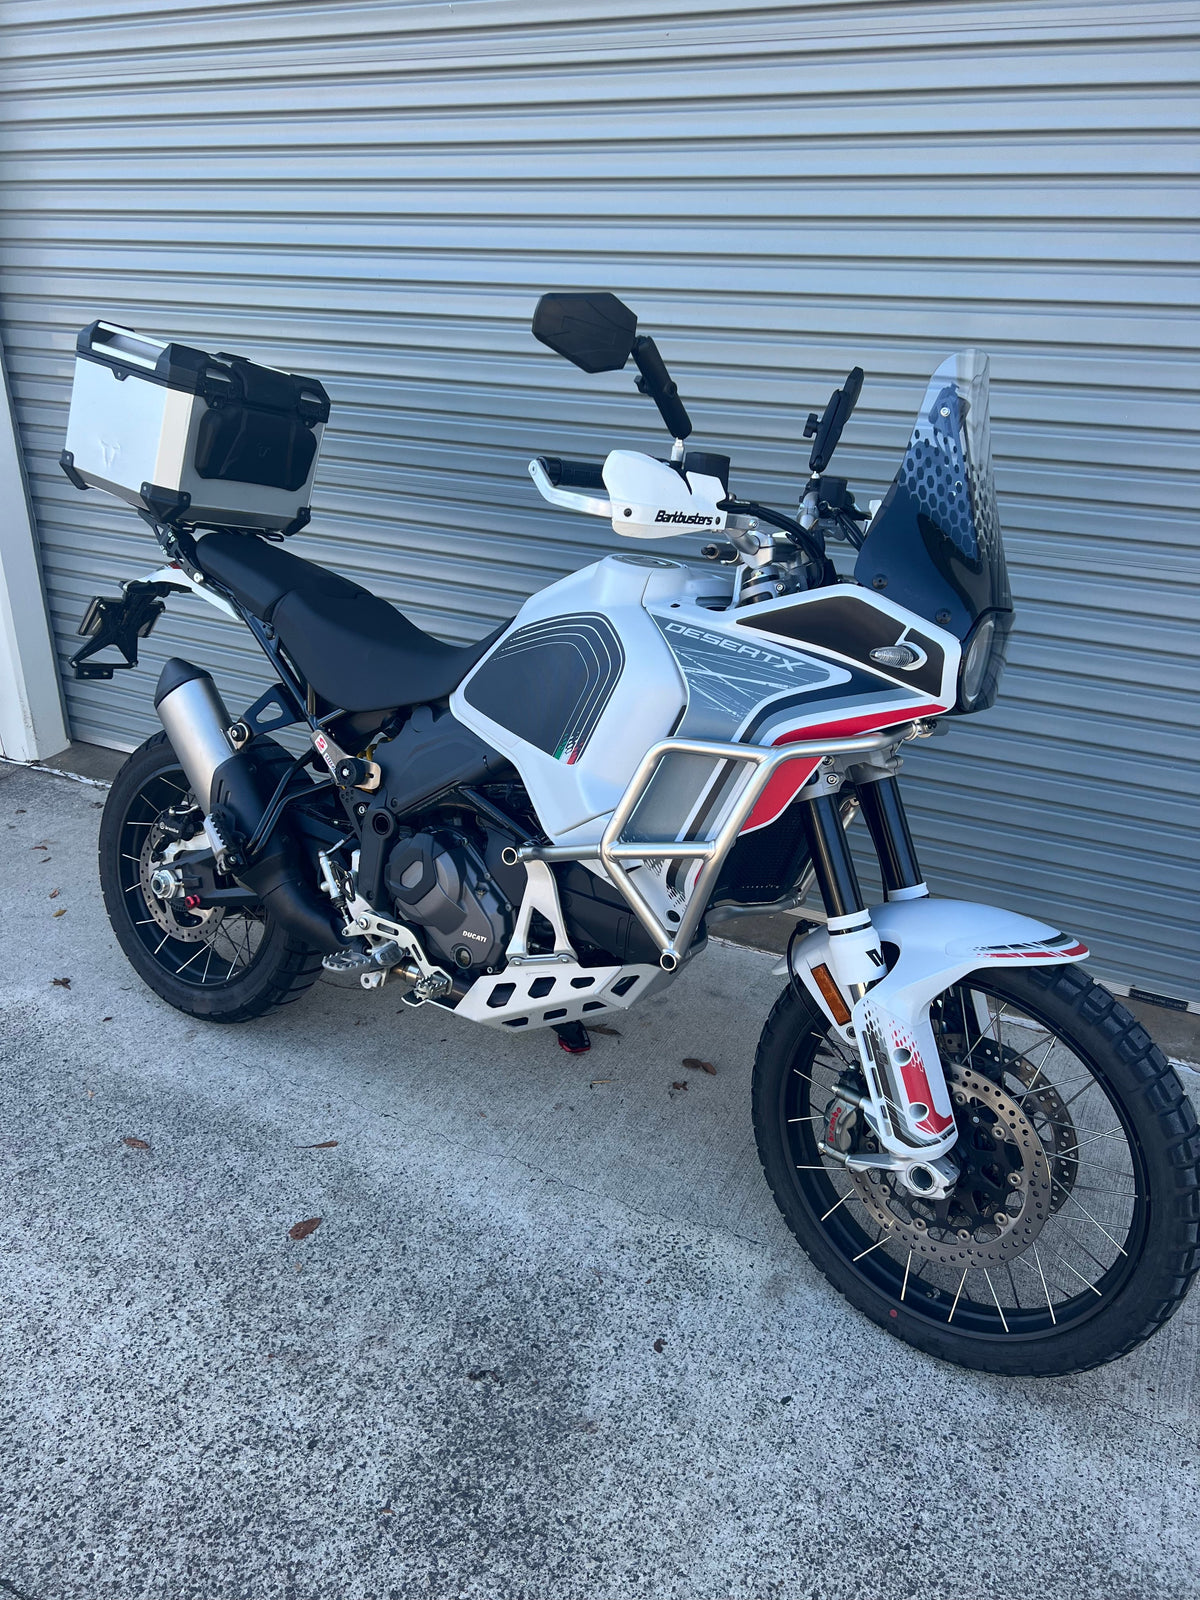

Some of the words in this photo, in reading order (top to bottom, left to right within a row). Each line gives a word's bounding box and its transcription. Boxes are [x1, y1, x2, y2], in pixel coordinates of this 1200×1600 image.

[655, 509, 713, 526] Barkbusters
[664, 622, 806, 672] DESERTX
[462, 930, 487, 943] DUCATI
[828, 1107, 842, 1142] brembo
